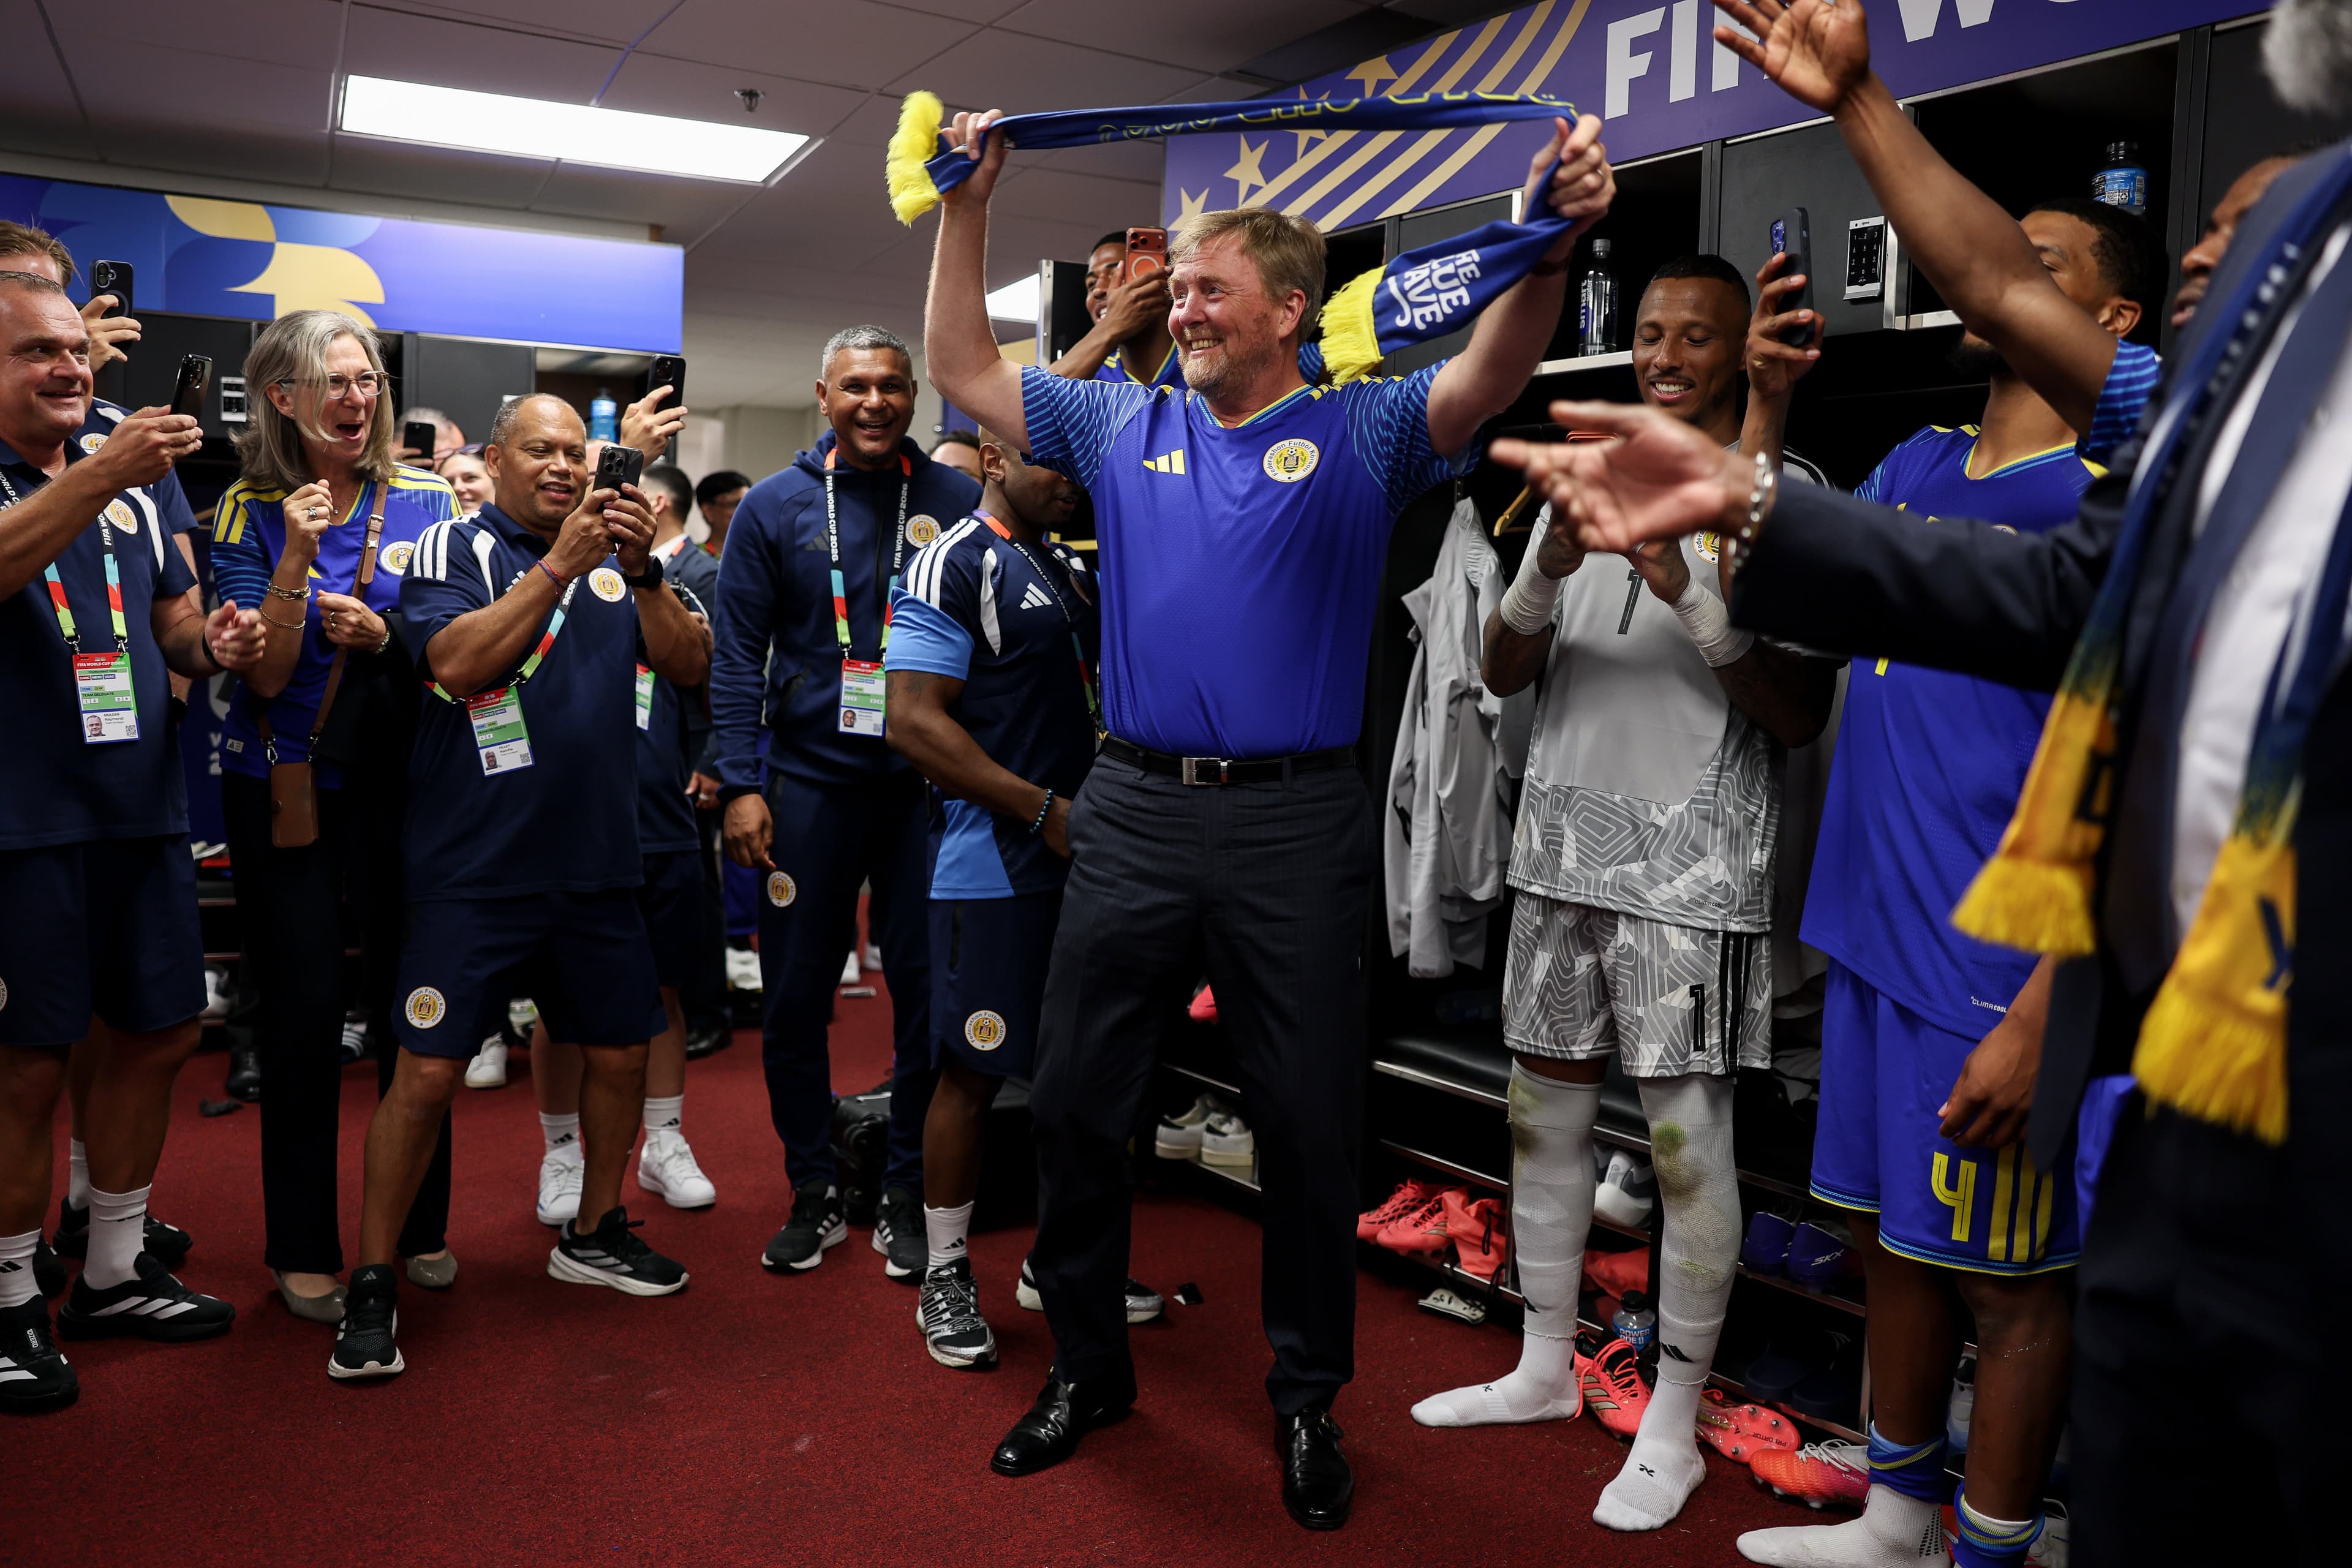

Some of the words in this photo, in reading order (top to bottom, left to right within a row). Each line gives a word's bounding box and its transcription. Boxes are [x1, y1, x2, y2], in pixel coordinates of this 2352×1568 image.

[1605, 0, 1770, 120] FIF
[1455, 249, 1481, 284] HE
[1403, 262, 1444, 330] AVE
[827, 492, 835, 518] WORLD
[899, 483, 908, 509] 2026
[102, 528, 112, 546] FIFA
[829, 535, 839, 562] 2026
[895, 524, 905, 552] WORLD
[1695, 530, 1705, 553] Federa
[1013, 543, 1029, 556] FIFA
[1028, 556, 1047, 580] WORLD
[1047, 581, 1058, 595] CUP
[1617, 568, 1644, 635] 1
[1689, 982, 1706, 1052] 1
[1972, 998, 2007, 1013] CLIMACOOL
[1931, 1151, 1977, 1243] 4
[1811, 1249, 1844, 1267] SKX
[1619, 1328, 1651, 1337] POWER
[1752, 1432, 1787, 1447] PREDATOR
